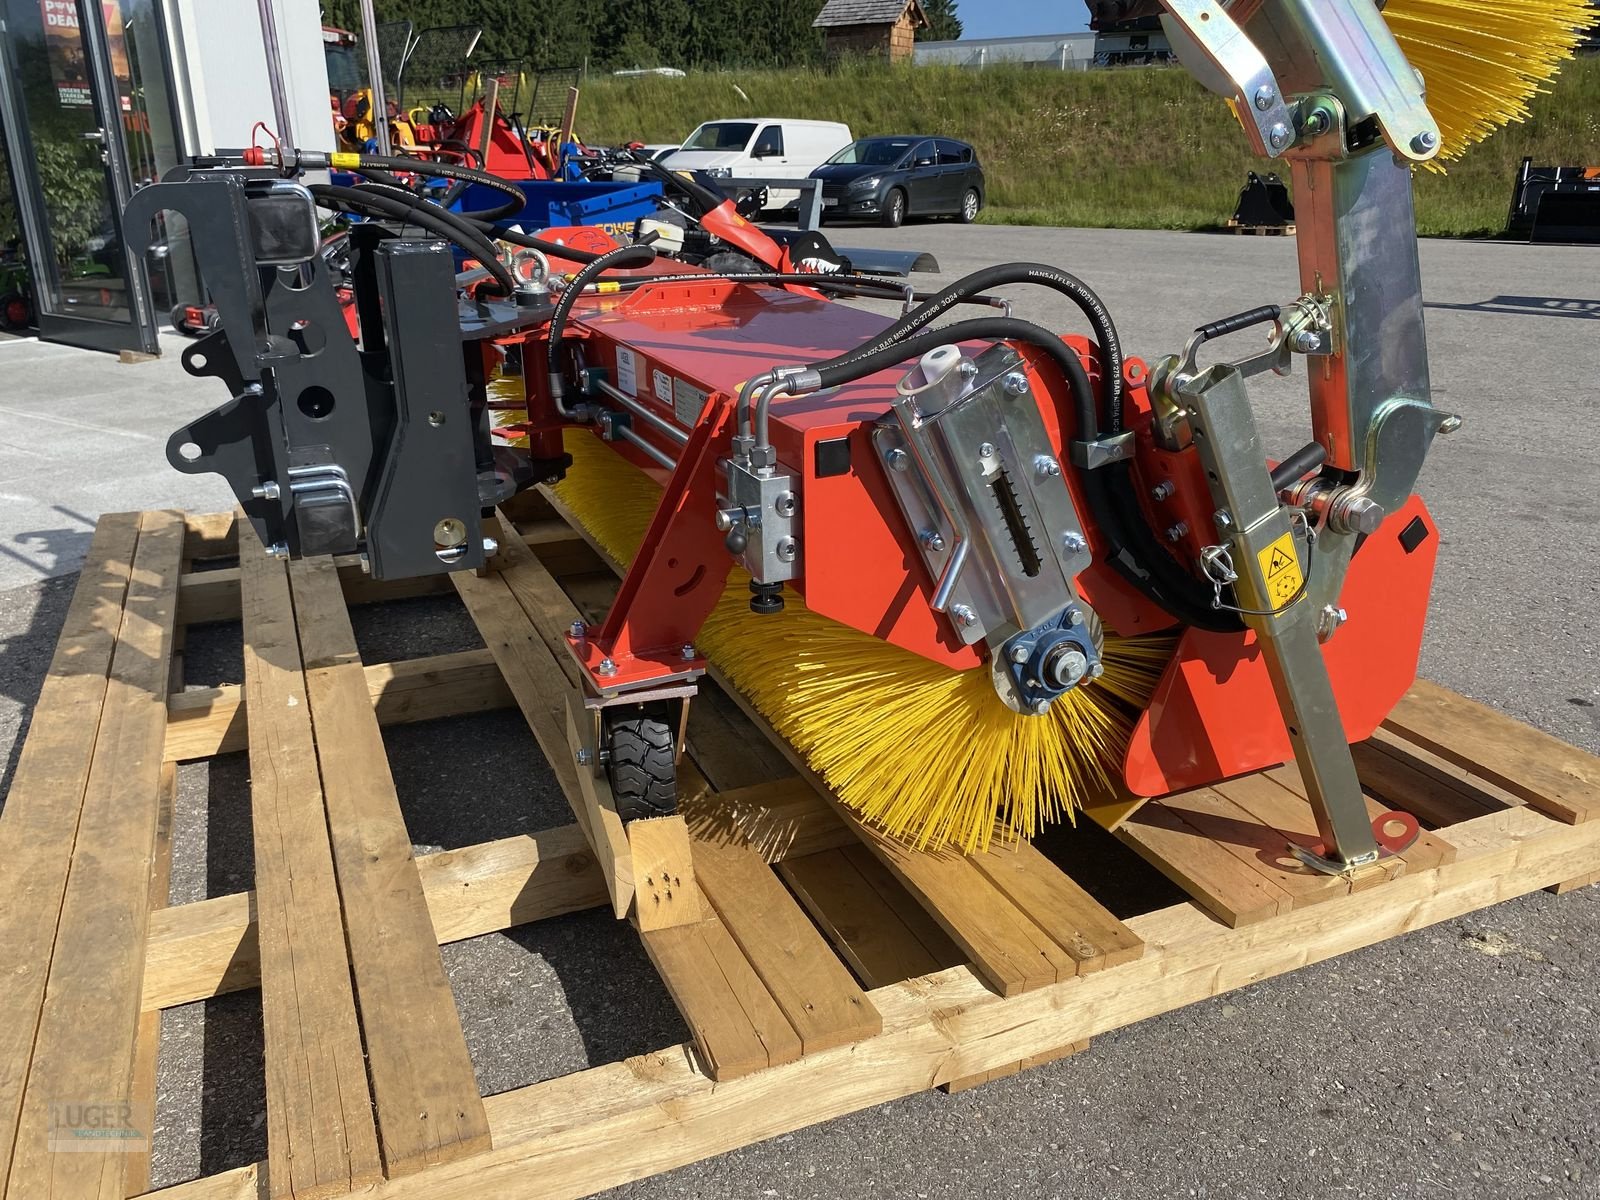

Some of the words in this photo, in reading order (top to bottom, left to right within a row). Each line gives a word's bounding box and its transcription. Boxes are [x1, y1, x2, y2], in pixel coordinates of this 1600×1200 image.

[1077, 286, 1097, 306] HD213
[1093, 304, 1103, 316] EN
[893, 324, 913, 341] MSHA
[1105, 327, 1115, 343] 2SN
[1109, 343, 1117, 352] 12
[1111, 351, 1119, 364] WP
[1112, 365, 1120, 379] 275
[1113, 379, 1121, 395] BAR
